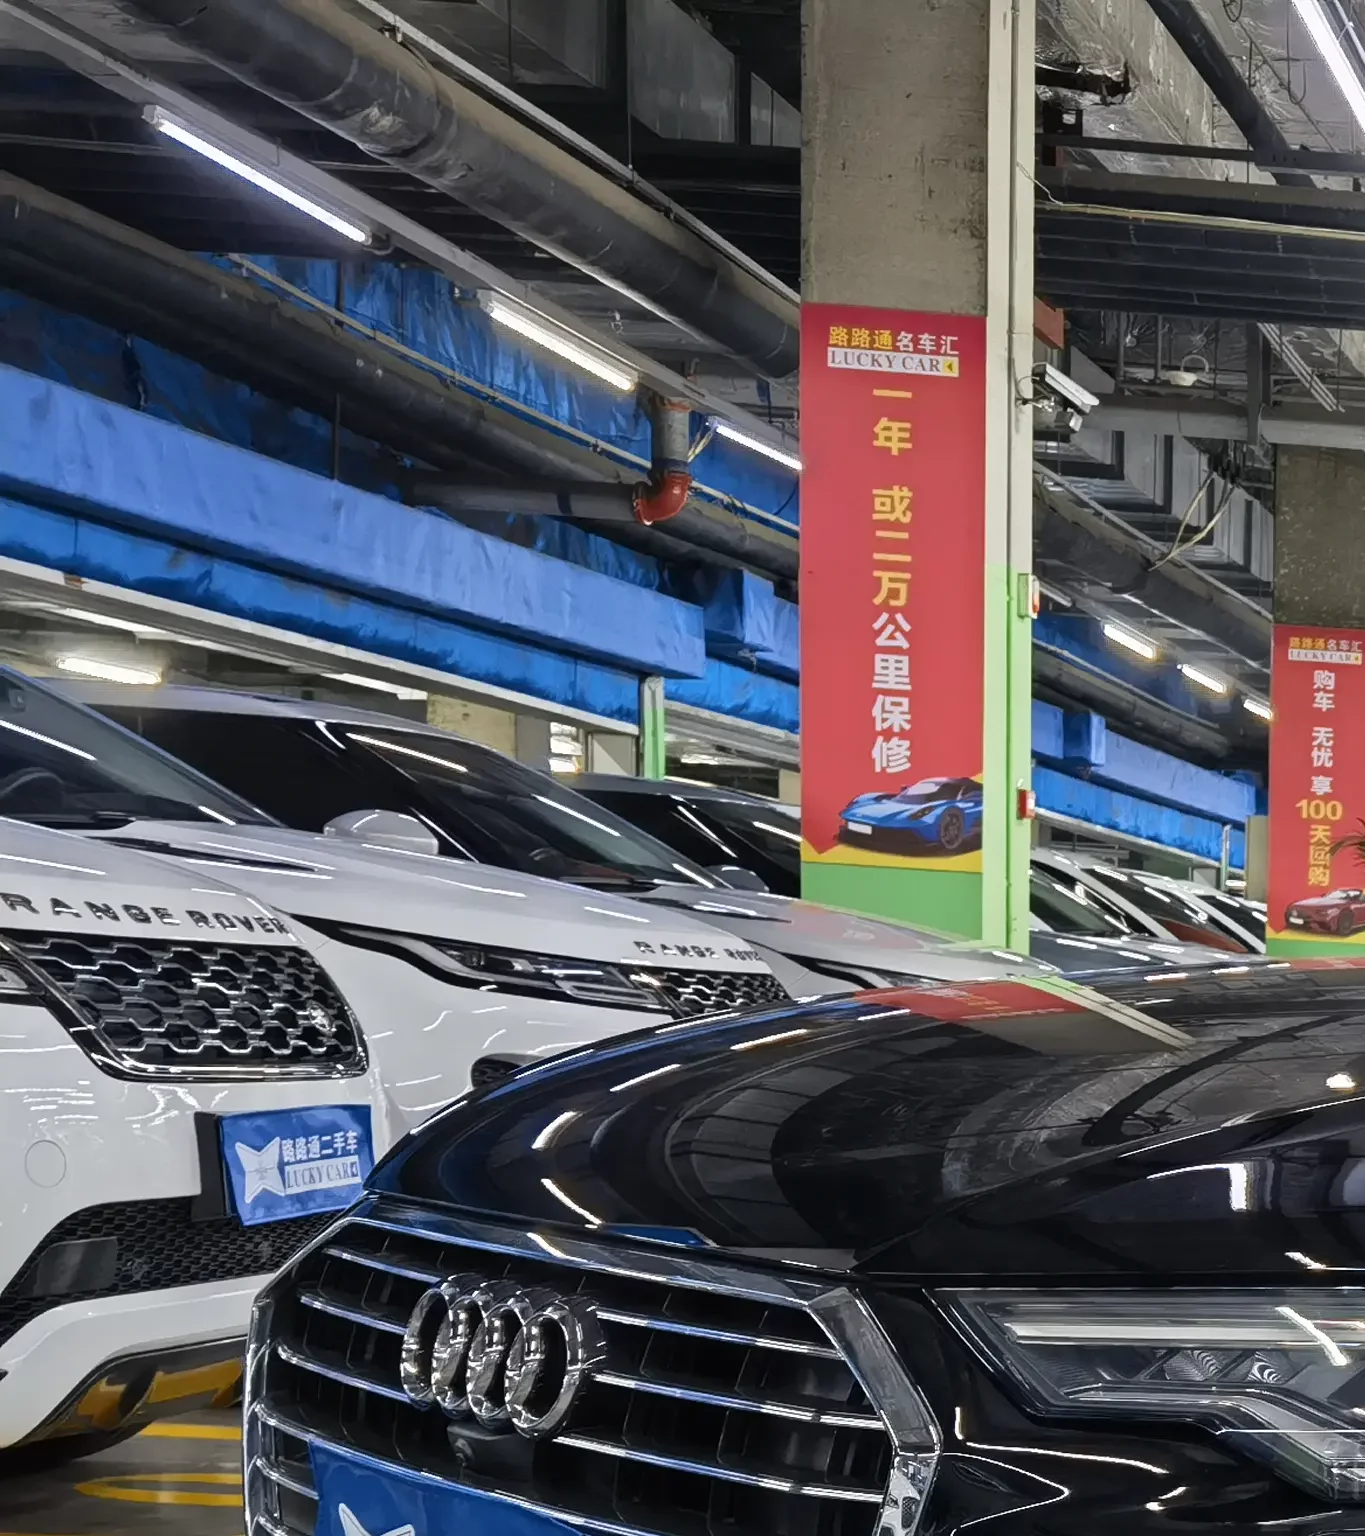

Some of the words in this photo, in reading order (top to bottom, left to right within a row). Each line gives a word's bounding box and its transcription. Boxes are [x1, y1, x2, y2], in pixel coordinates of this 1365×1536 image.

[829, 326, 959, 355] 路路通名车汇
[831, 350, 896, 369] LUCKY
[902, 355, 941, 372] CAR
[0, 893, 181, 925] RANGE
[282, 1130, 358, 1163] 路路通二手车
[287, 1165, 325, 1189] LUCKY
[326, 1162, 351, 1182] CAR
